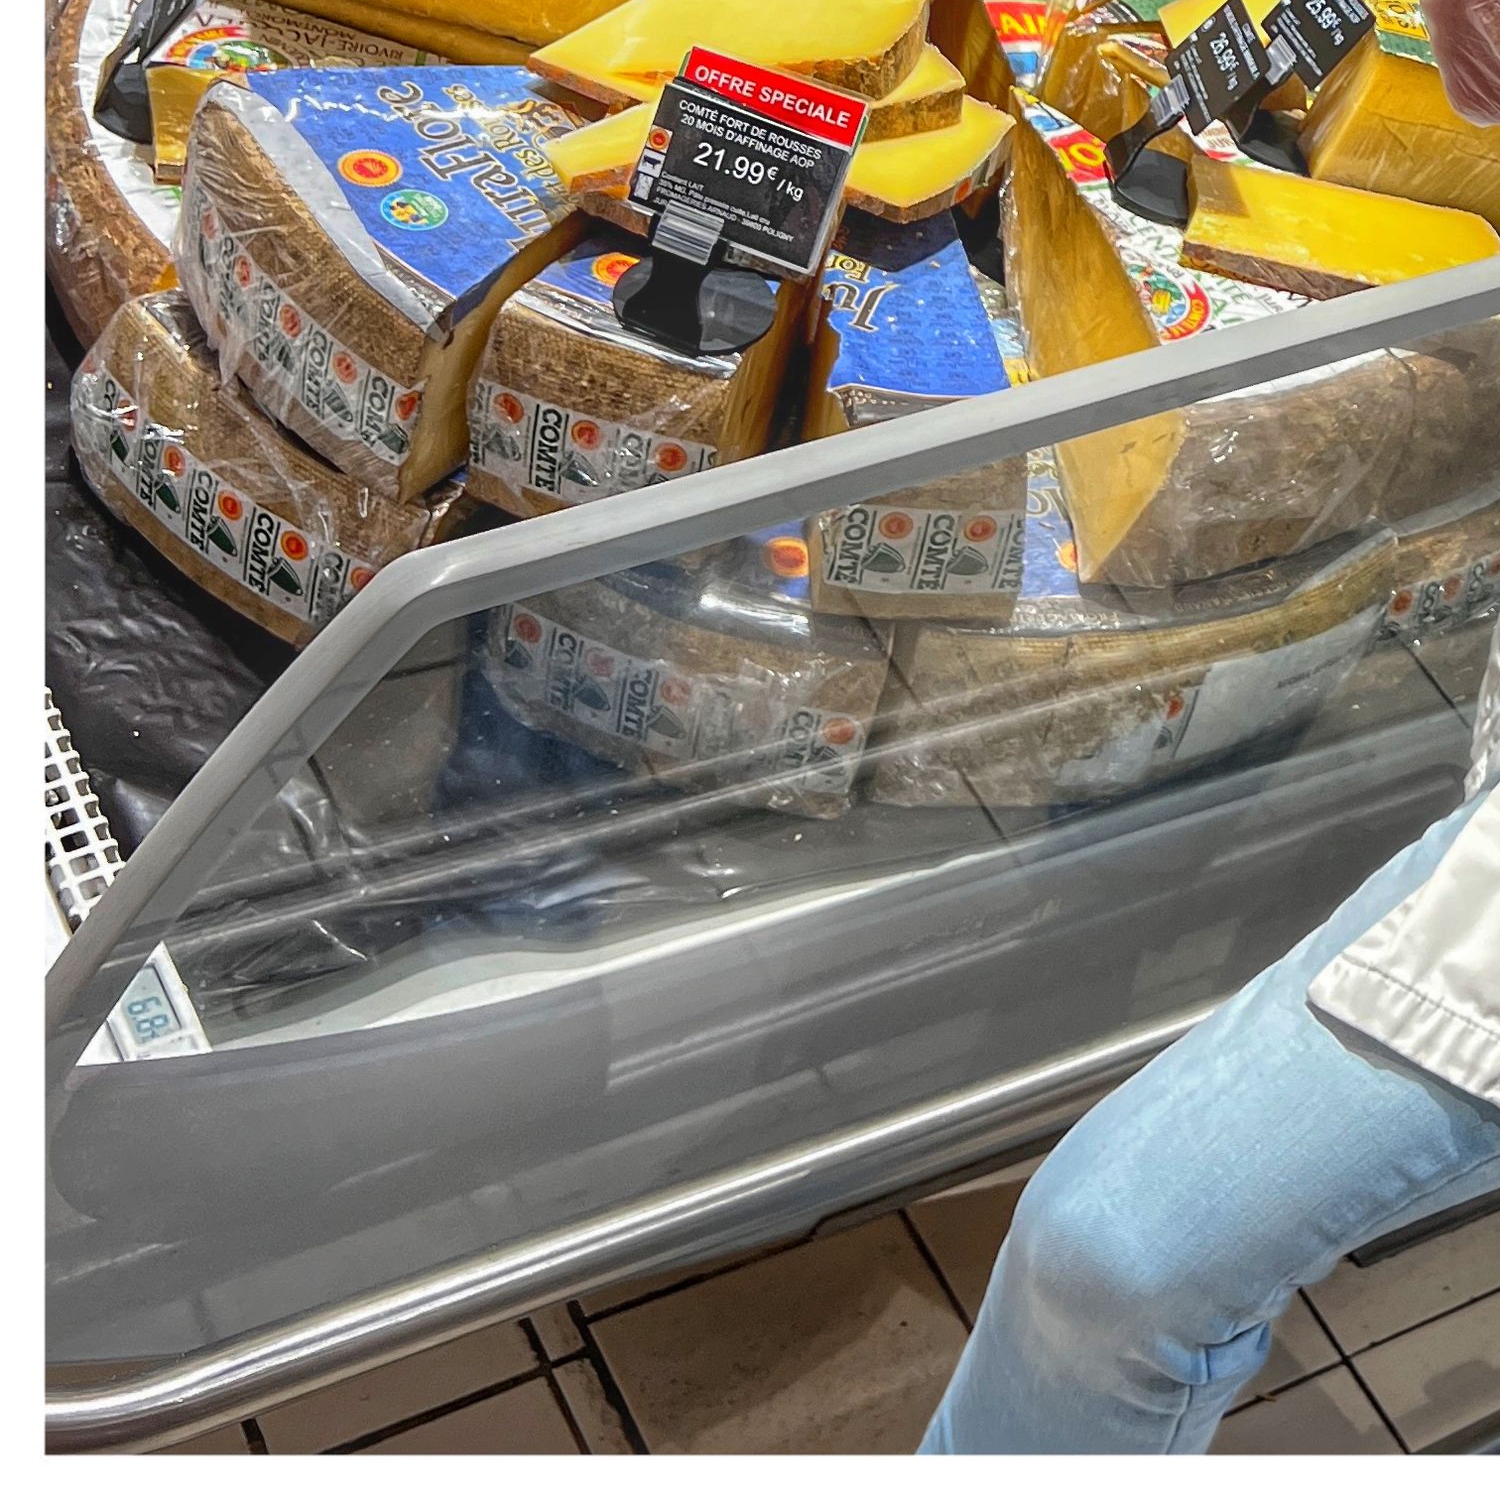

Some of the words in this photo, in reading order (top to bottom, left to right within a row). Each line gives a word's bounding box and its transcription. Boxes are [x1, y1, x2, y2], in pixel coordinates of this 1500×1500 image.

[694, 65, 756, 99] OFFRE
[758, 85, 852, 129] SPECIALE
[680, 113, 694, 127] 20
[694, 118, 724, 140] MOIS
[725, 128, 790, 162] D'AFFINAGE
[788, 151, 816, 170] AOP
[719, 112, 750, 133] FORT
[750, 122, 767, 140] DE
[768, 129, 823, 161] ROUSSES
[692, 141, 779, 186] 21.99€
